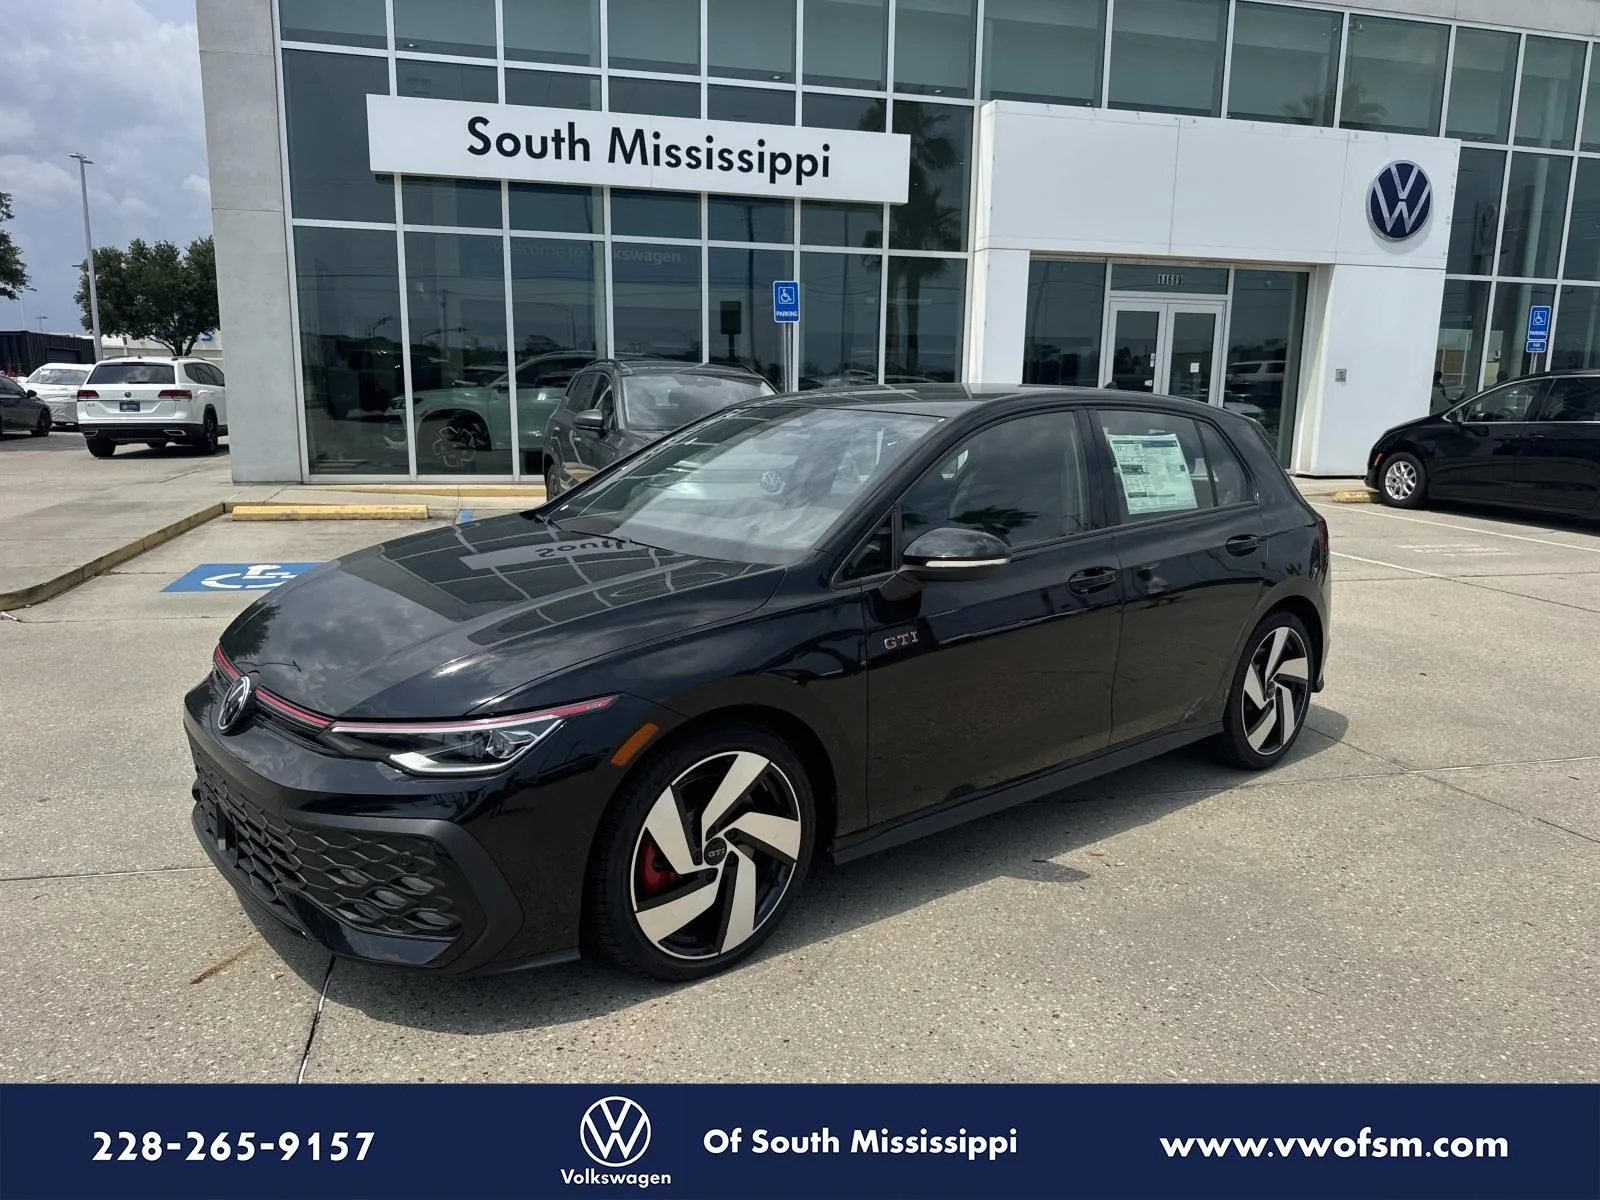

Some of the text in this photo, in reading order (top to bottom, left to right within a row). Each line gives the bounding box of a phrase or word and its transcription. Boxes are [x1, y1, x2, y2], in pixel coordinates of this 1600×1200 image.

[467, 116, 830, 185] South Mississippi
[1371, 162, 1431, 234] VW
[884, 631, 919, 649] GTI
